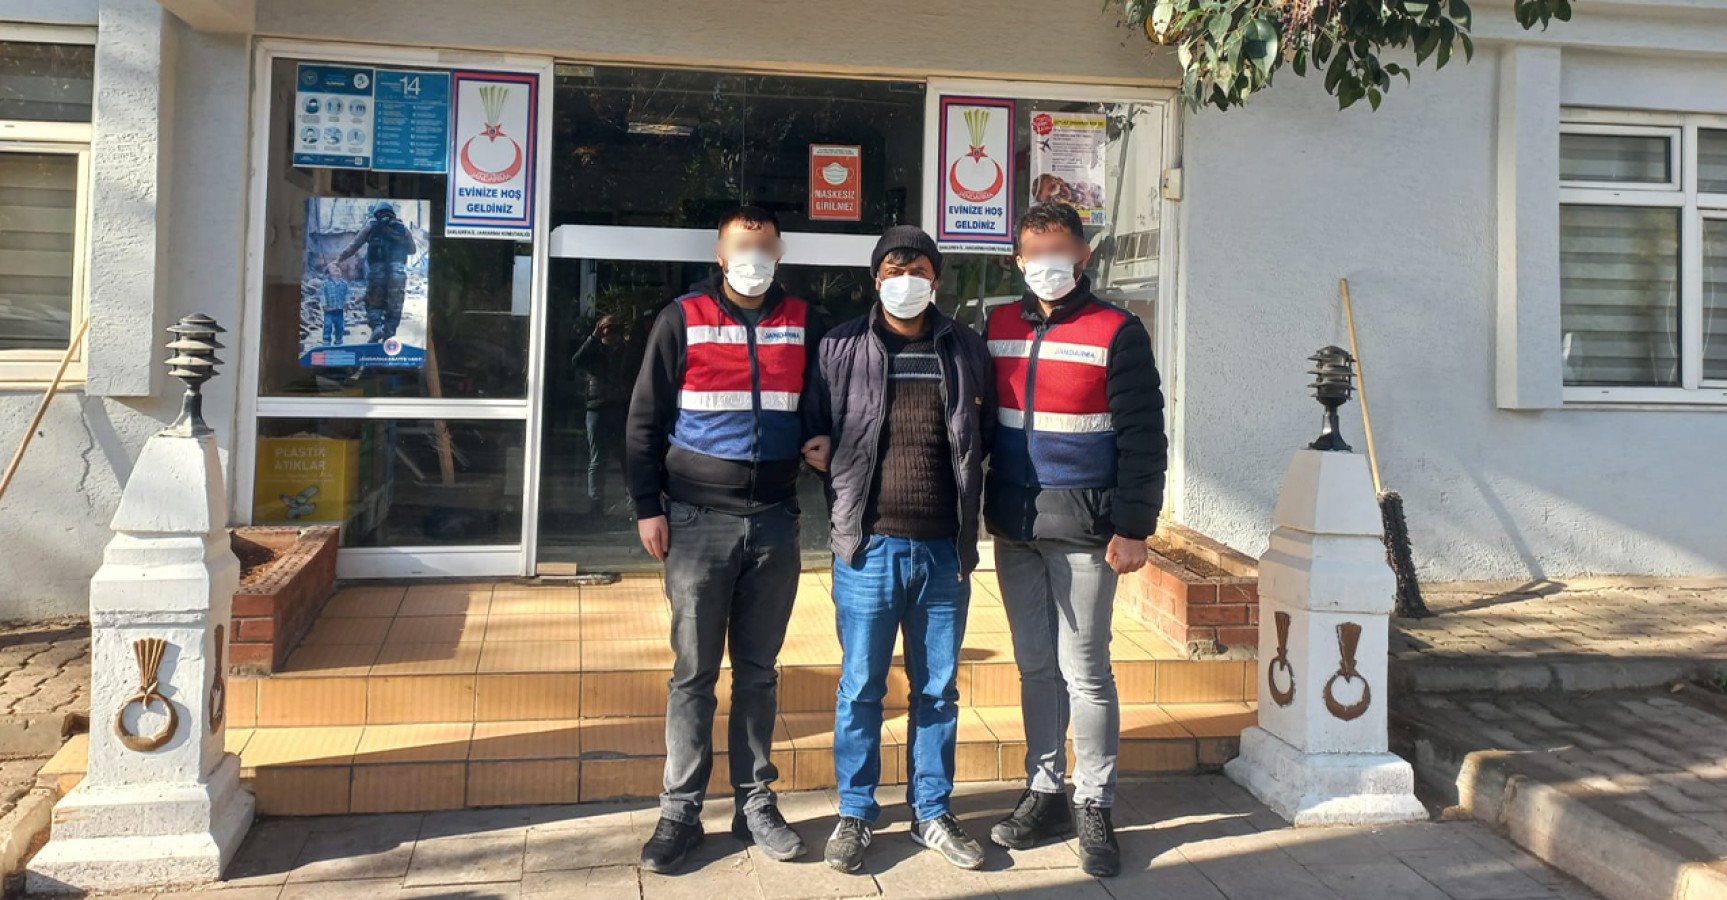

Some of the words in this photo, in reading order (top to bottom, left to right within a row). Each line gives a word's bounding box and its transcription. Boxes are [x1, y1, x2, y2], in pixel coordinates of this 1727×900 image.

[400, 76, 422, 96] 14
[458, 186, 498, 198] EVİNİZE
[501, 189, 522, 201] HOŞ
[814, 188, 855, 199] MASKESİZ
[466, 203, 513, 214] GELDİNİZ
[815, 200, 854, 211] GİRİLMEZ
[949, 204, 983, 215] EVİNİZE
[985, 207, 1003, 217] HOŞ
[955, 218, 996, 230] GELDİNİZ
[763, 331, 800, 340] JANDARMA
[1054, 348, 1096, 359] JANDARMA
[275, 445, 325, 458] PLASTİK
[274, 459, 325, 470] ATIKLAR
